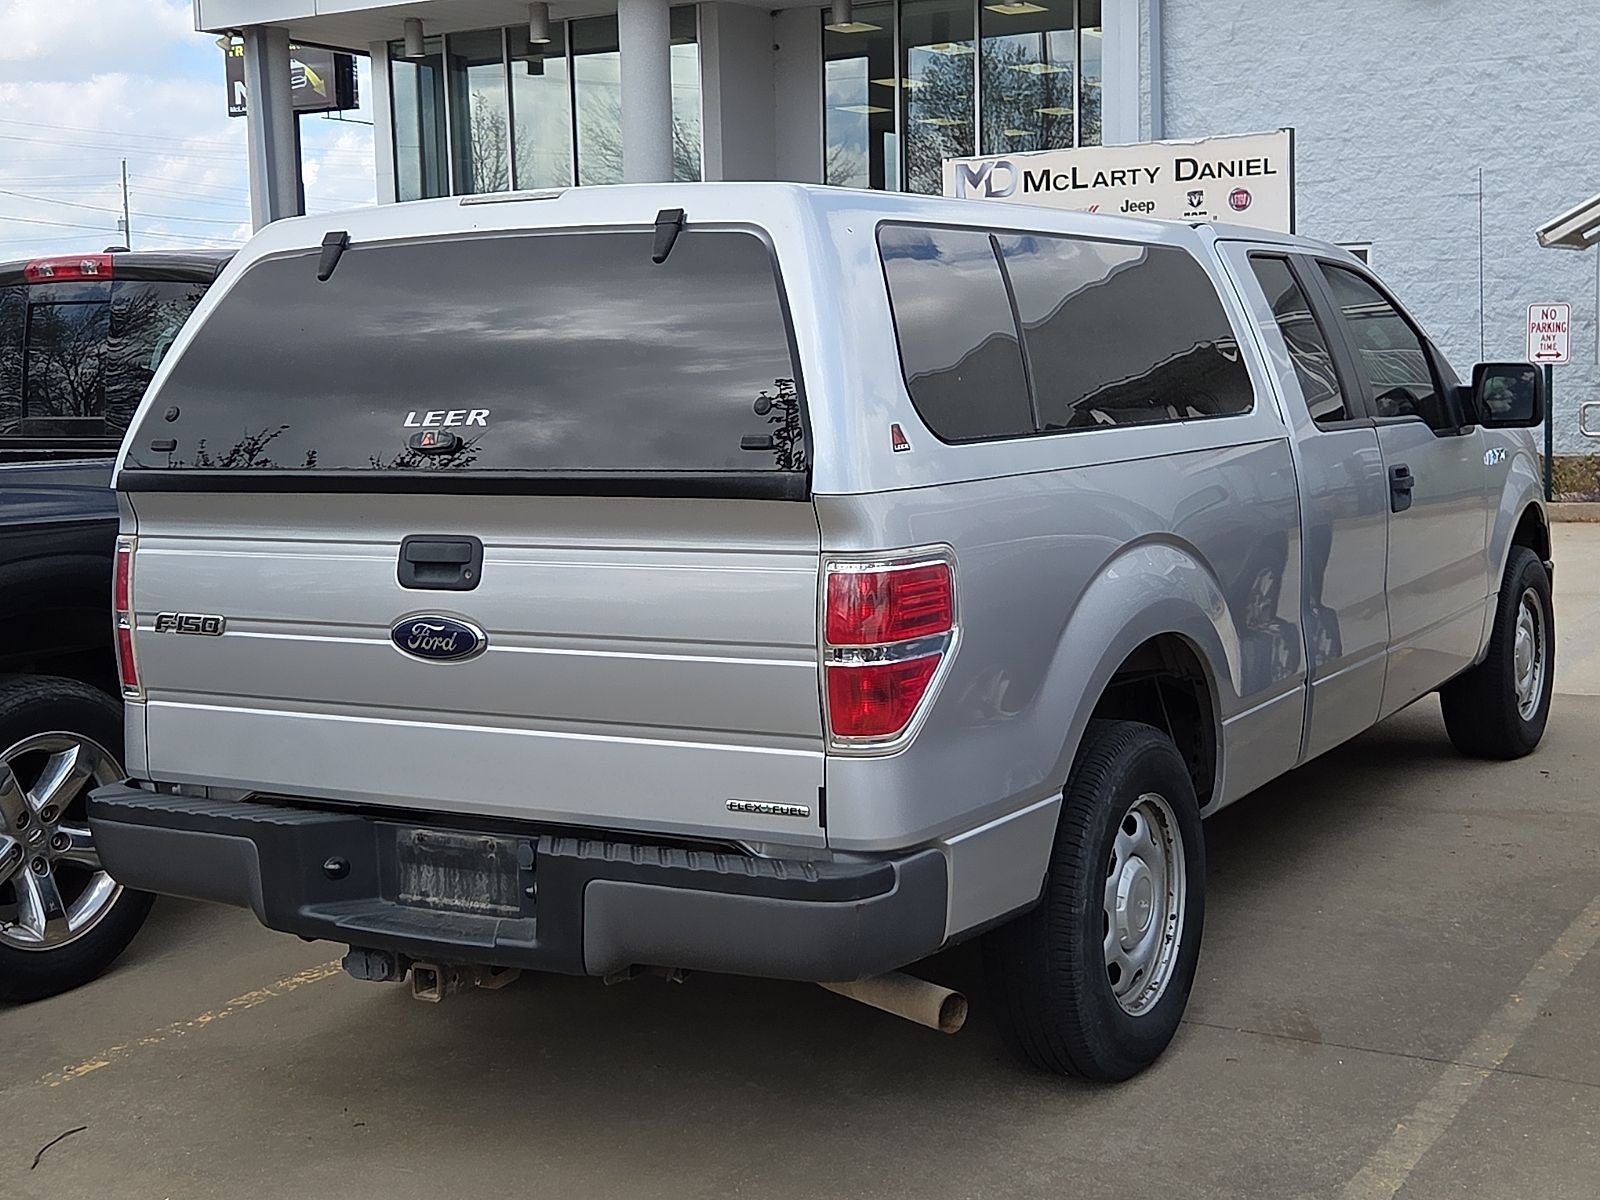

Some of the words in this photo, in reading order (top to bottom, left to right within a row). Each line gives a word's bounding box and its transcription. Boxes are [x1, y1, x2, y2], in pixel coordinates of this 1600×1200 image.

[1175, 158, 1277, 182] DANIEL
[1120, 199, 1155, 214] Jeep
[1541, 308, 1557, 320] NO
[1531, 322, 1567, 333] PARKING
[1541, 334, 1556, 342] ANY
[1540, 343, 1557, 351] TIME
[403, 409, 490, 427] LEER
[155, 612, 225, 636] F-150
[407, 622, 459, 651] Ford
